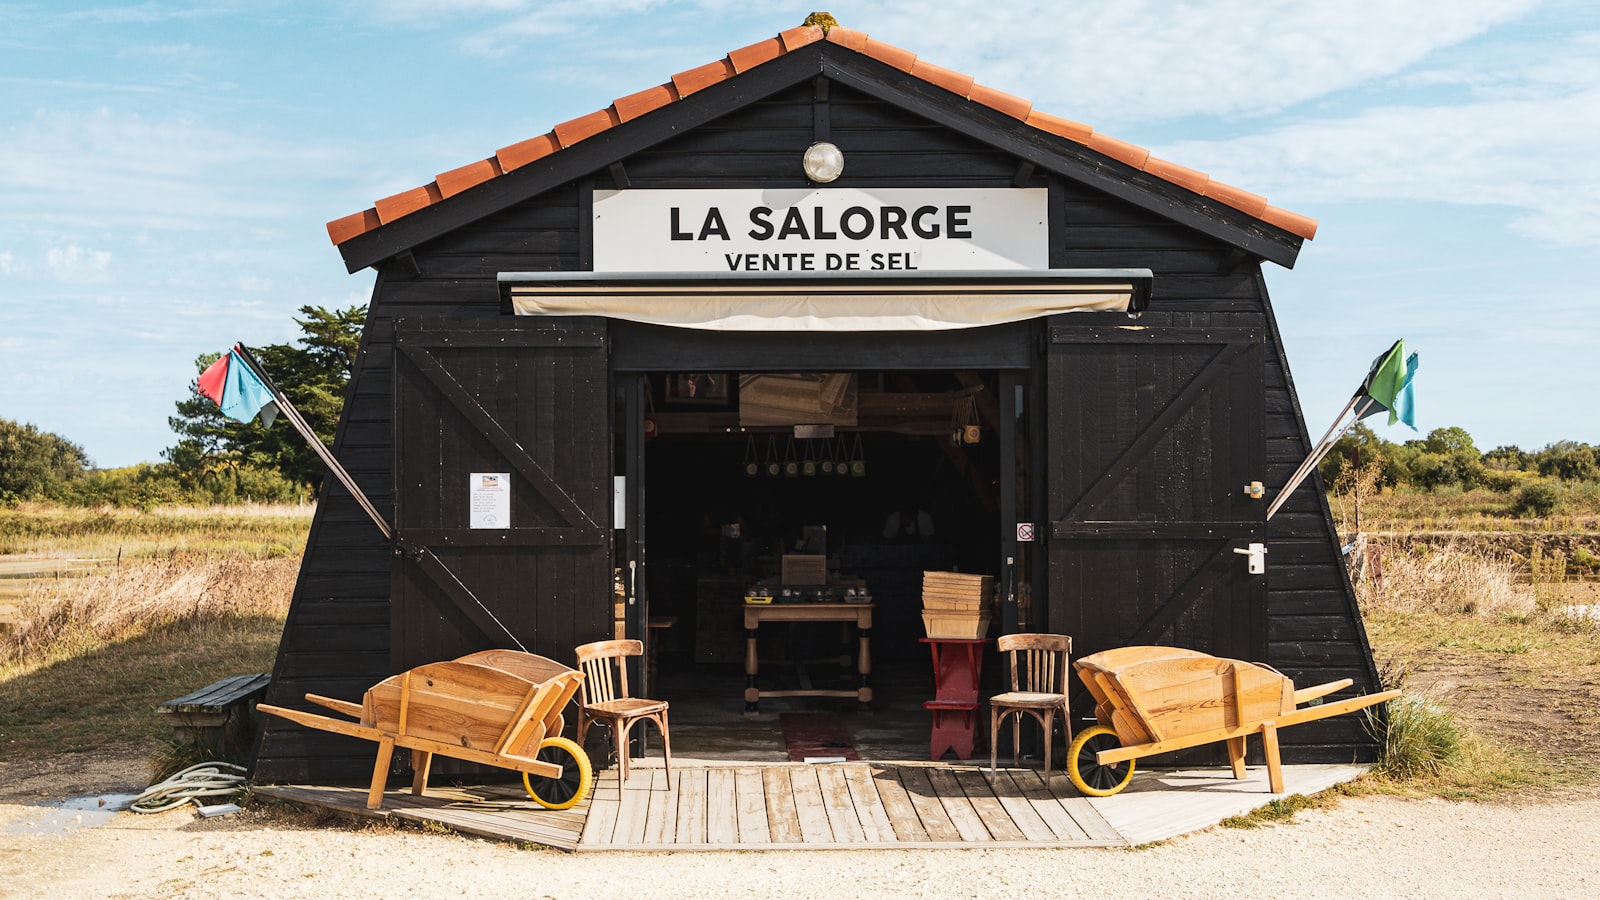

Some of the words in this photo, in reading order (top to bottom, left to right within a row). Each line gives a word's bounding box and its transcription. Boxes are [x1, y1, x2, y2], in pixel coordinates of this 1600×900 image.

[670, 207, 731, 241] LA
[748, 205, 972, 241] SALORGE
[725, 253, 815, 271] VENTE
[826, 253, 860, 271] DE
[870, 252, 918, 271] SEL
